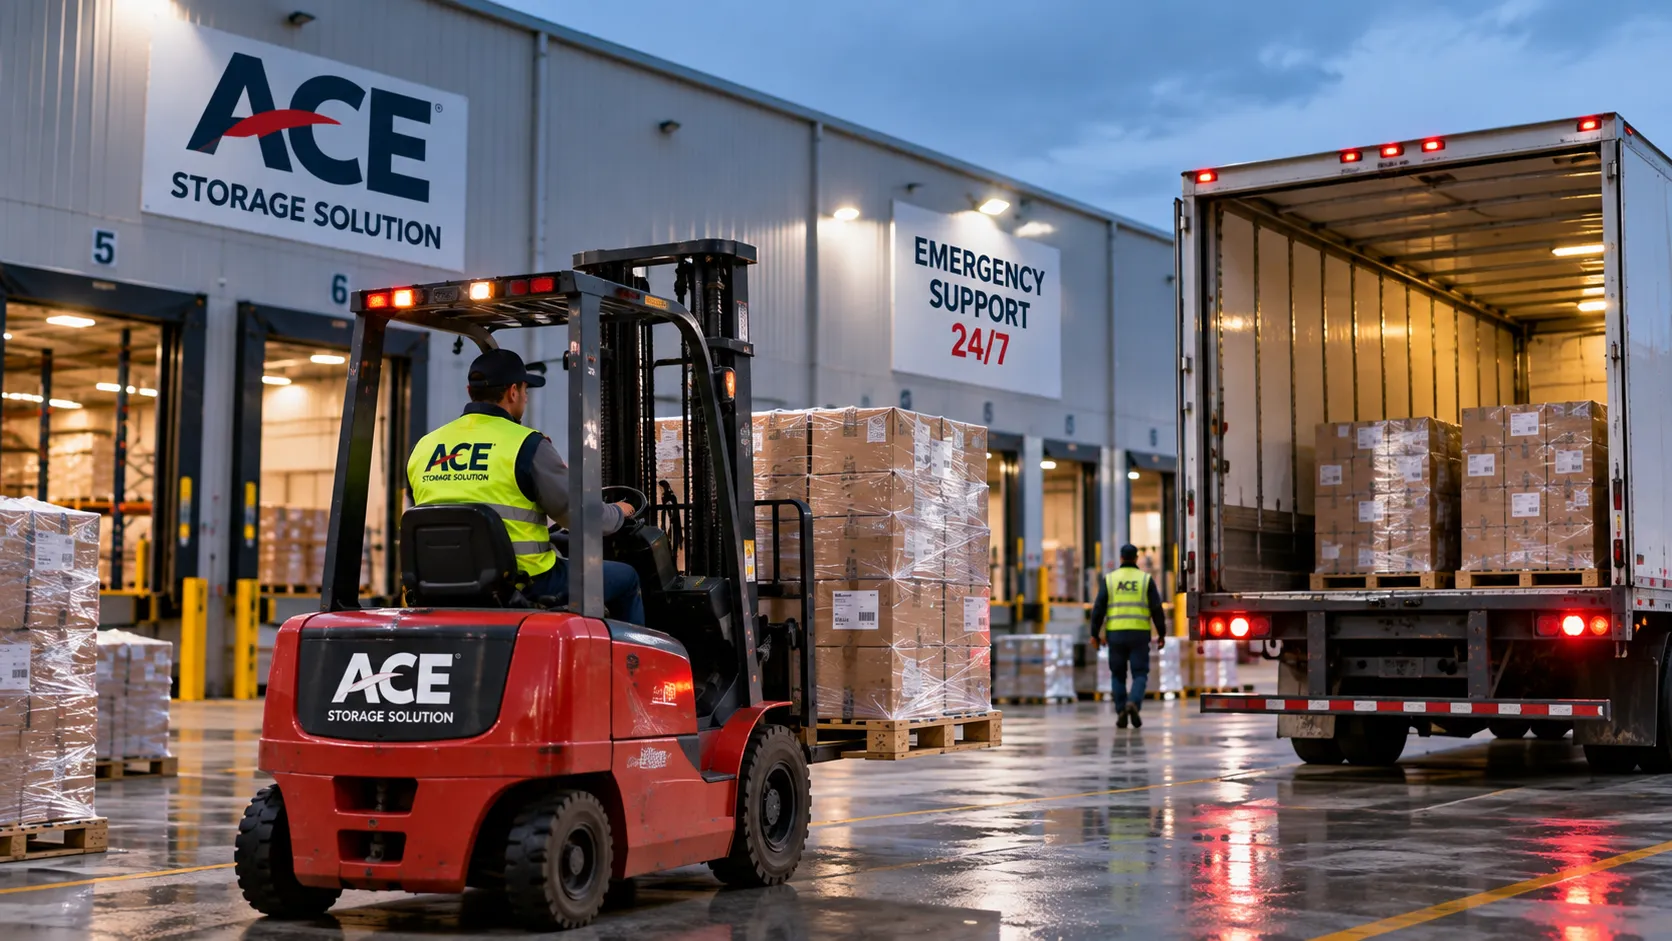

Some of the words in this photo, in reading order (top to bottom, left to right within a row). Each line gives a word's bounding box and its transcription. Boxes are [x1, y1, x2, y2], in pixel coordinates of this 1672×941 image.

[187, 53, 431, 203] ACE
[171, 172, 305, 223] STORAGE
[312, 201, 441, 250] SOLUTION
[95, 231, 113, 265] 5
[914, 236, 1046, 295] EMERGENCY
[331, 274, 347, 305] 6
[929, 279, 1031, 329] SUPPORT
[951, 322, 1010, 366] 24/7
[424, 442, 492, 472] ACE
[453, 473, 489, 481] SOLUTION
[1117, 580, 1138, 592] ACE
[331, 652, 453, 704] ACE
[328, 709, 384, 722] STORAGE
[388, 710, 454, 723] SOLUTION
